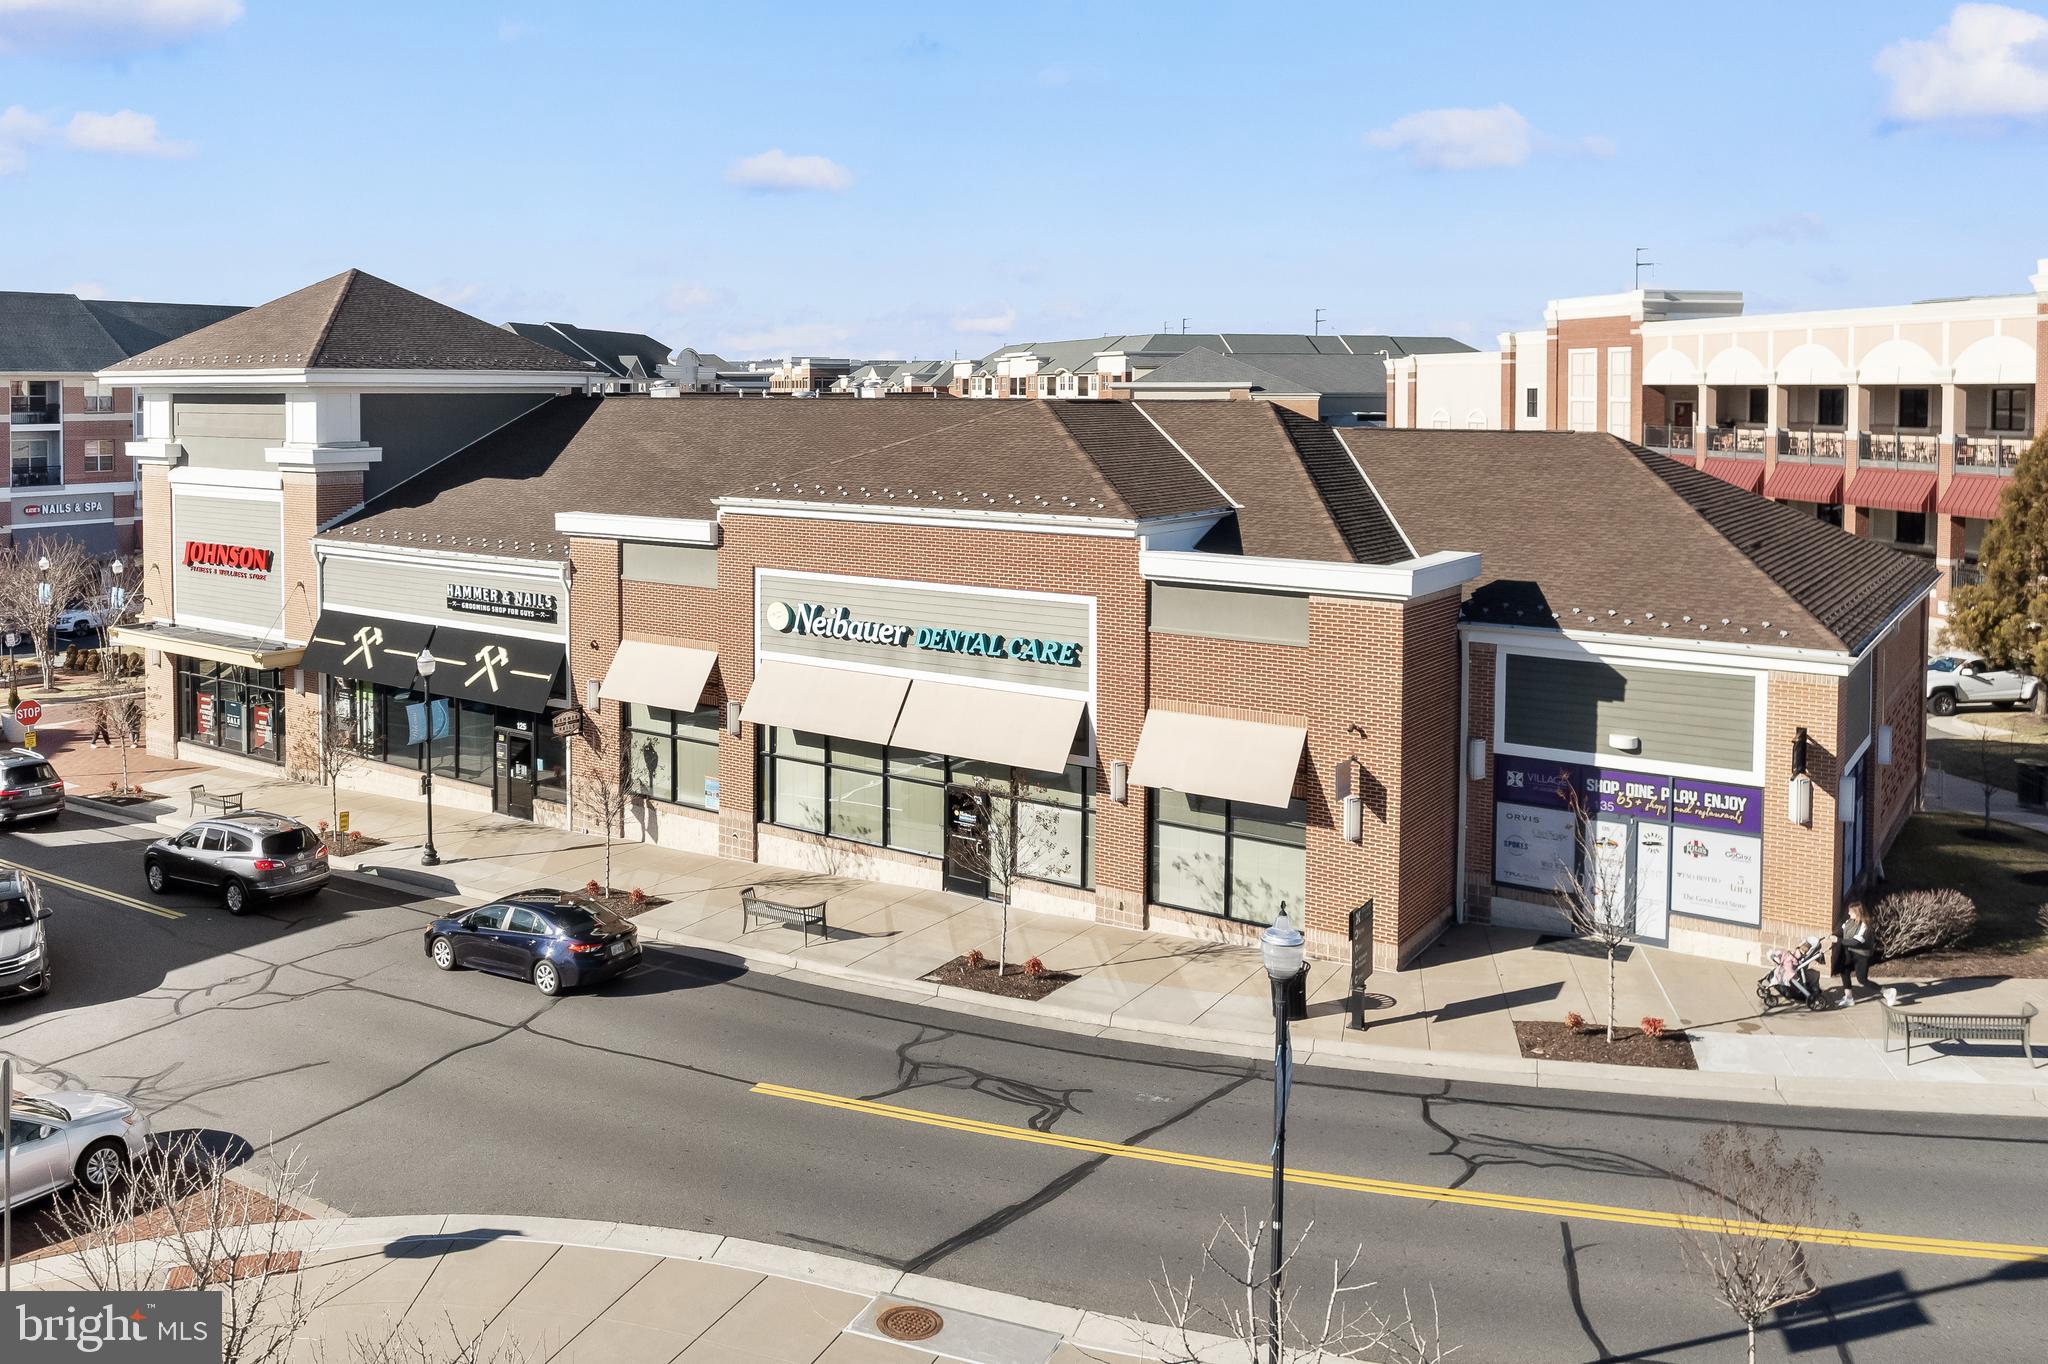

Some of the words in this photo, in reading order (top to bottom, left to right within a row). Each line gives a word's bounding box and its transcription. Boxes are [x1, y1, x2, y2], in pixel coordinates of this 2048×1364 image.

[42, 504, 71, 514] NAILS
[75, 503, 81, 512] &
[85, 502, 103, 511] SPA
[182, 541, 270, 571] JOHNSON
[446, 584, 498, 602] HAMMER
[502, 590, 514, 603] &
[514, 591, 553, 608] NAILS
[461, 602, 491, 612] GROOMING
[491, 605, 506, 614] SHOP
[507, 608, 519, 616] FOR
[519, 609, 535, 618] GUYS
[792, 602, 907, 645] Neibauer
[915, 627, 1002, 656] DENTAL
[1008, 637, 1075, 664] CARE
[17, 707, 40, 719] STOP
[226, 716, 241, 726] SALE
[1704, 792, 1747, 812] ENJOY
[1506, 813, 1540, 823] ORVIS
